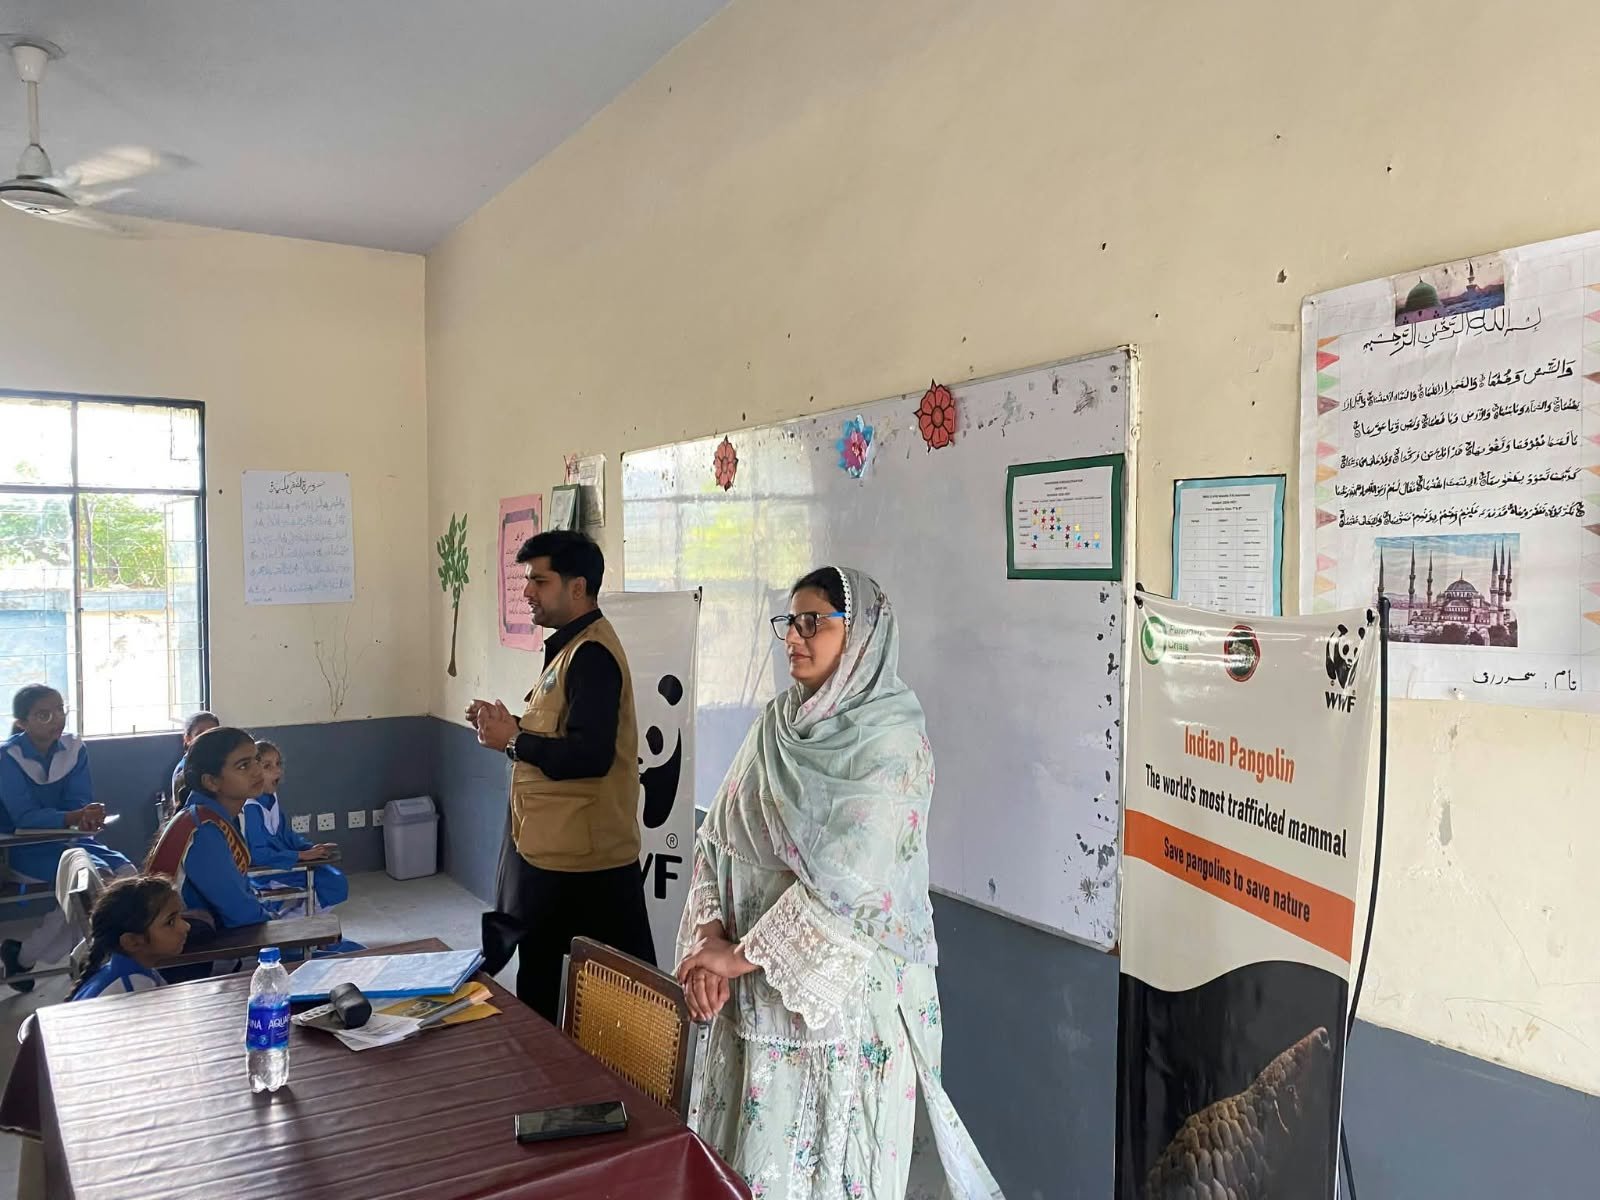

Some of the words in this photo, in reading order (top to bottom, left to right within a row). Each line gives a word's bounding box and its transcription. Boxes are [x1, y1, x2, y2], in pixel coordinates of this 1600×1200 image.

[1184, 726, 1225, 765] Indian
[1229, 736, 1295, 784] Pangolin
[1145, 763, 1161, 790] The
[1163, 775, 1196, 804] world's
[1199, 788, 1226, 815] most
[1227, 796, 1285, 835] trafficked
[1288, 815, 1347, 858] mammal
[1163, 836, 1184, 865] Save
[1186, 852, 1231, 886] pangolins
[1233, 872, 1244, 892] to
[1246, 878, 1270, 904] save
[1273, 890, 1311, 923] nature
